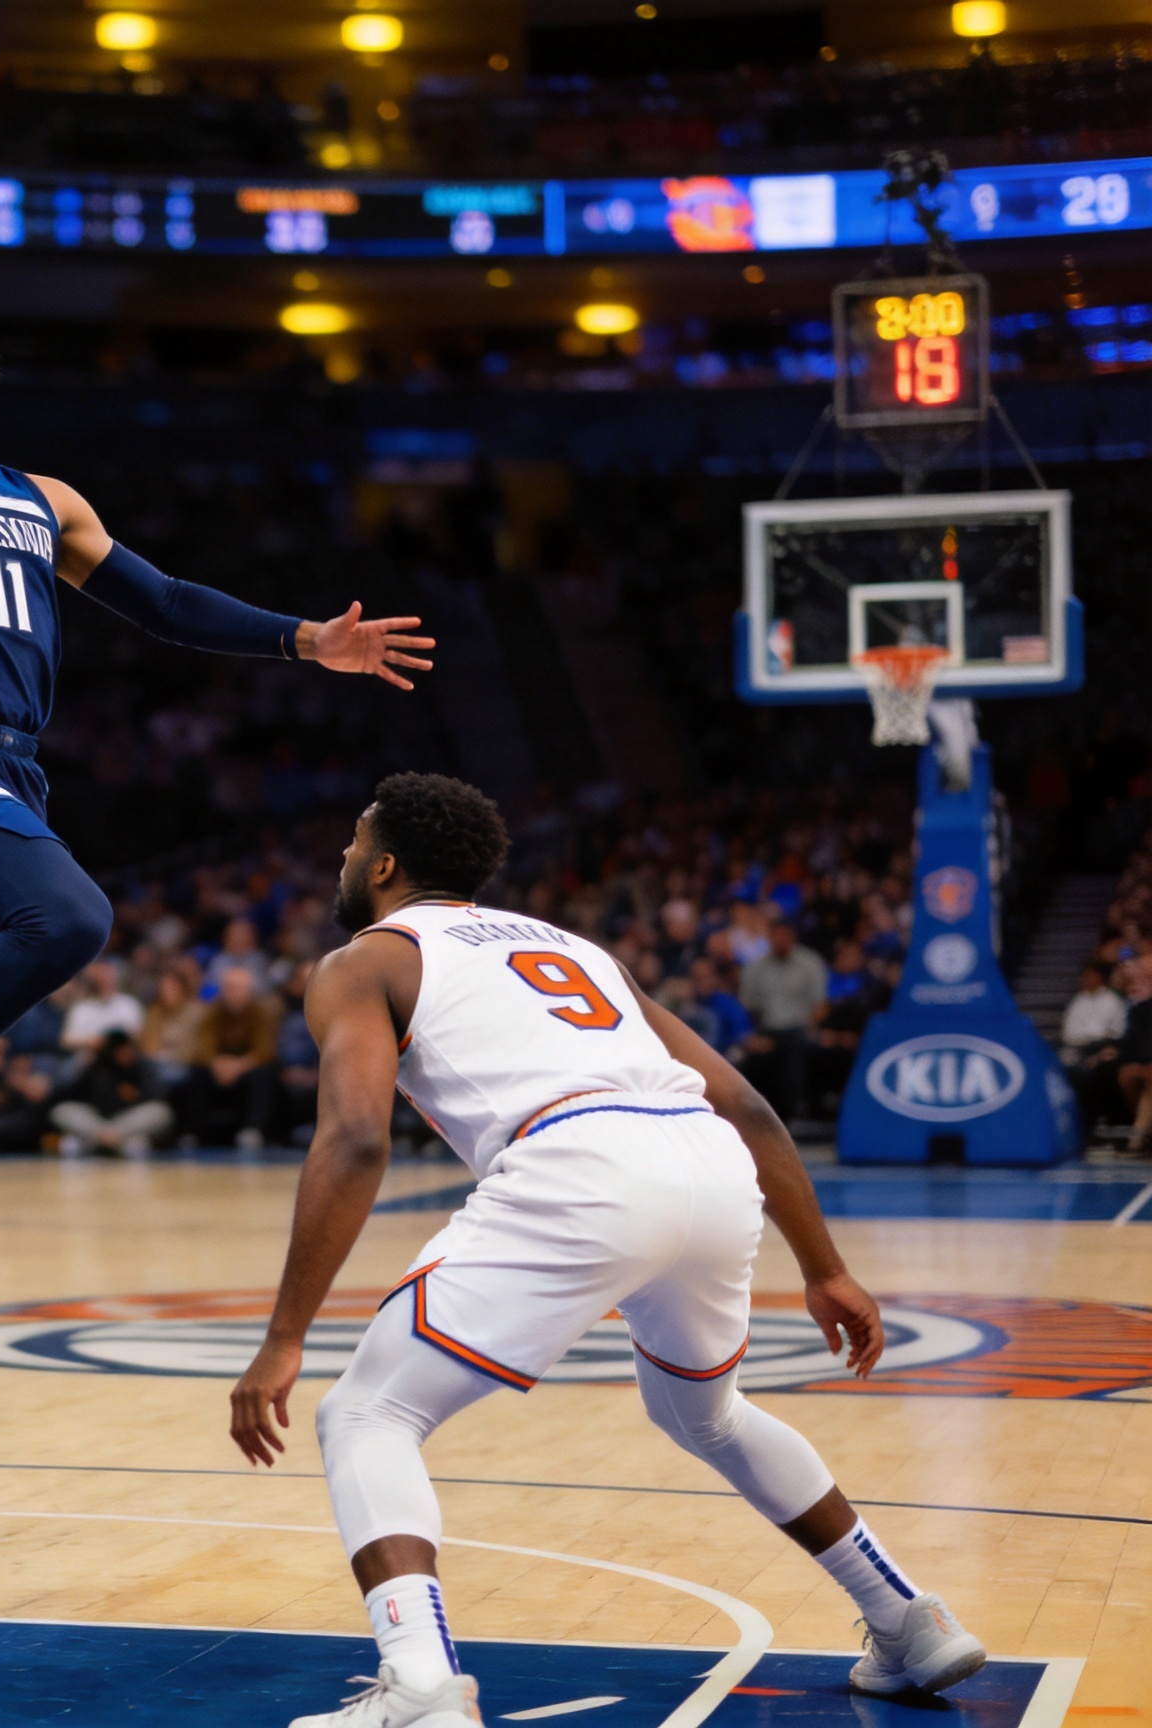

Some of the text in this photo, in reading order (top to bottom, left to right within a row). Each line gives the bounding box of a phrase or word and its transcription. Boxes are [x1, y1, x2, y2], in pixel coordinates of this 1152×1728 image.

[894, 336, 961, 406] 18
[505, 950, 624, 1032] 9
[895, 1050, 1002, 1107] KIA
